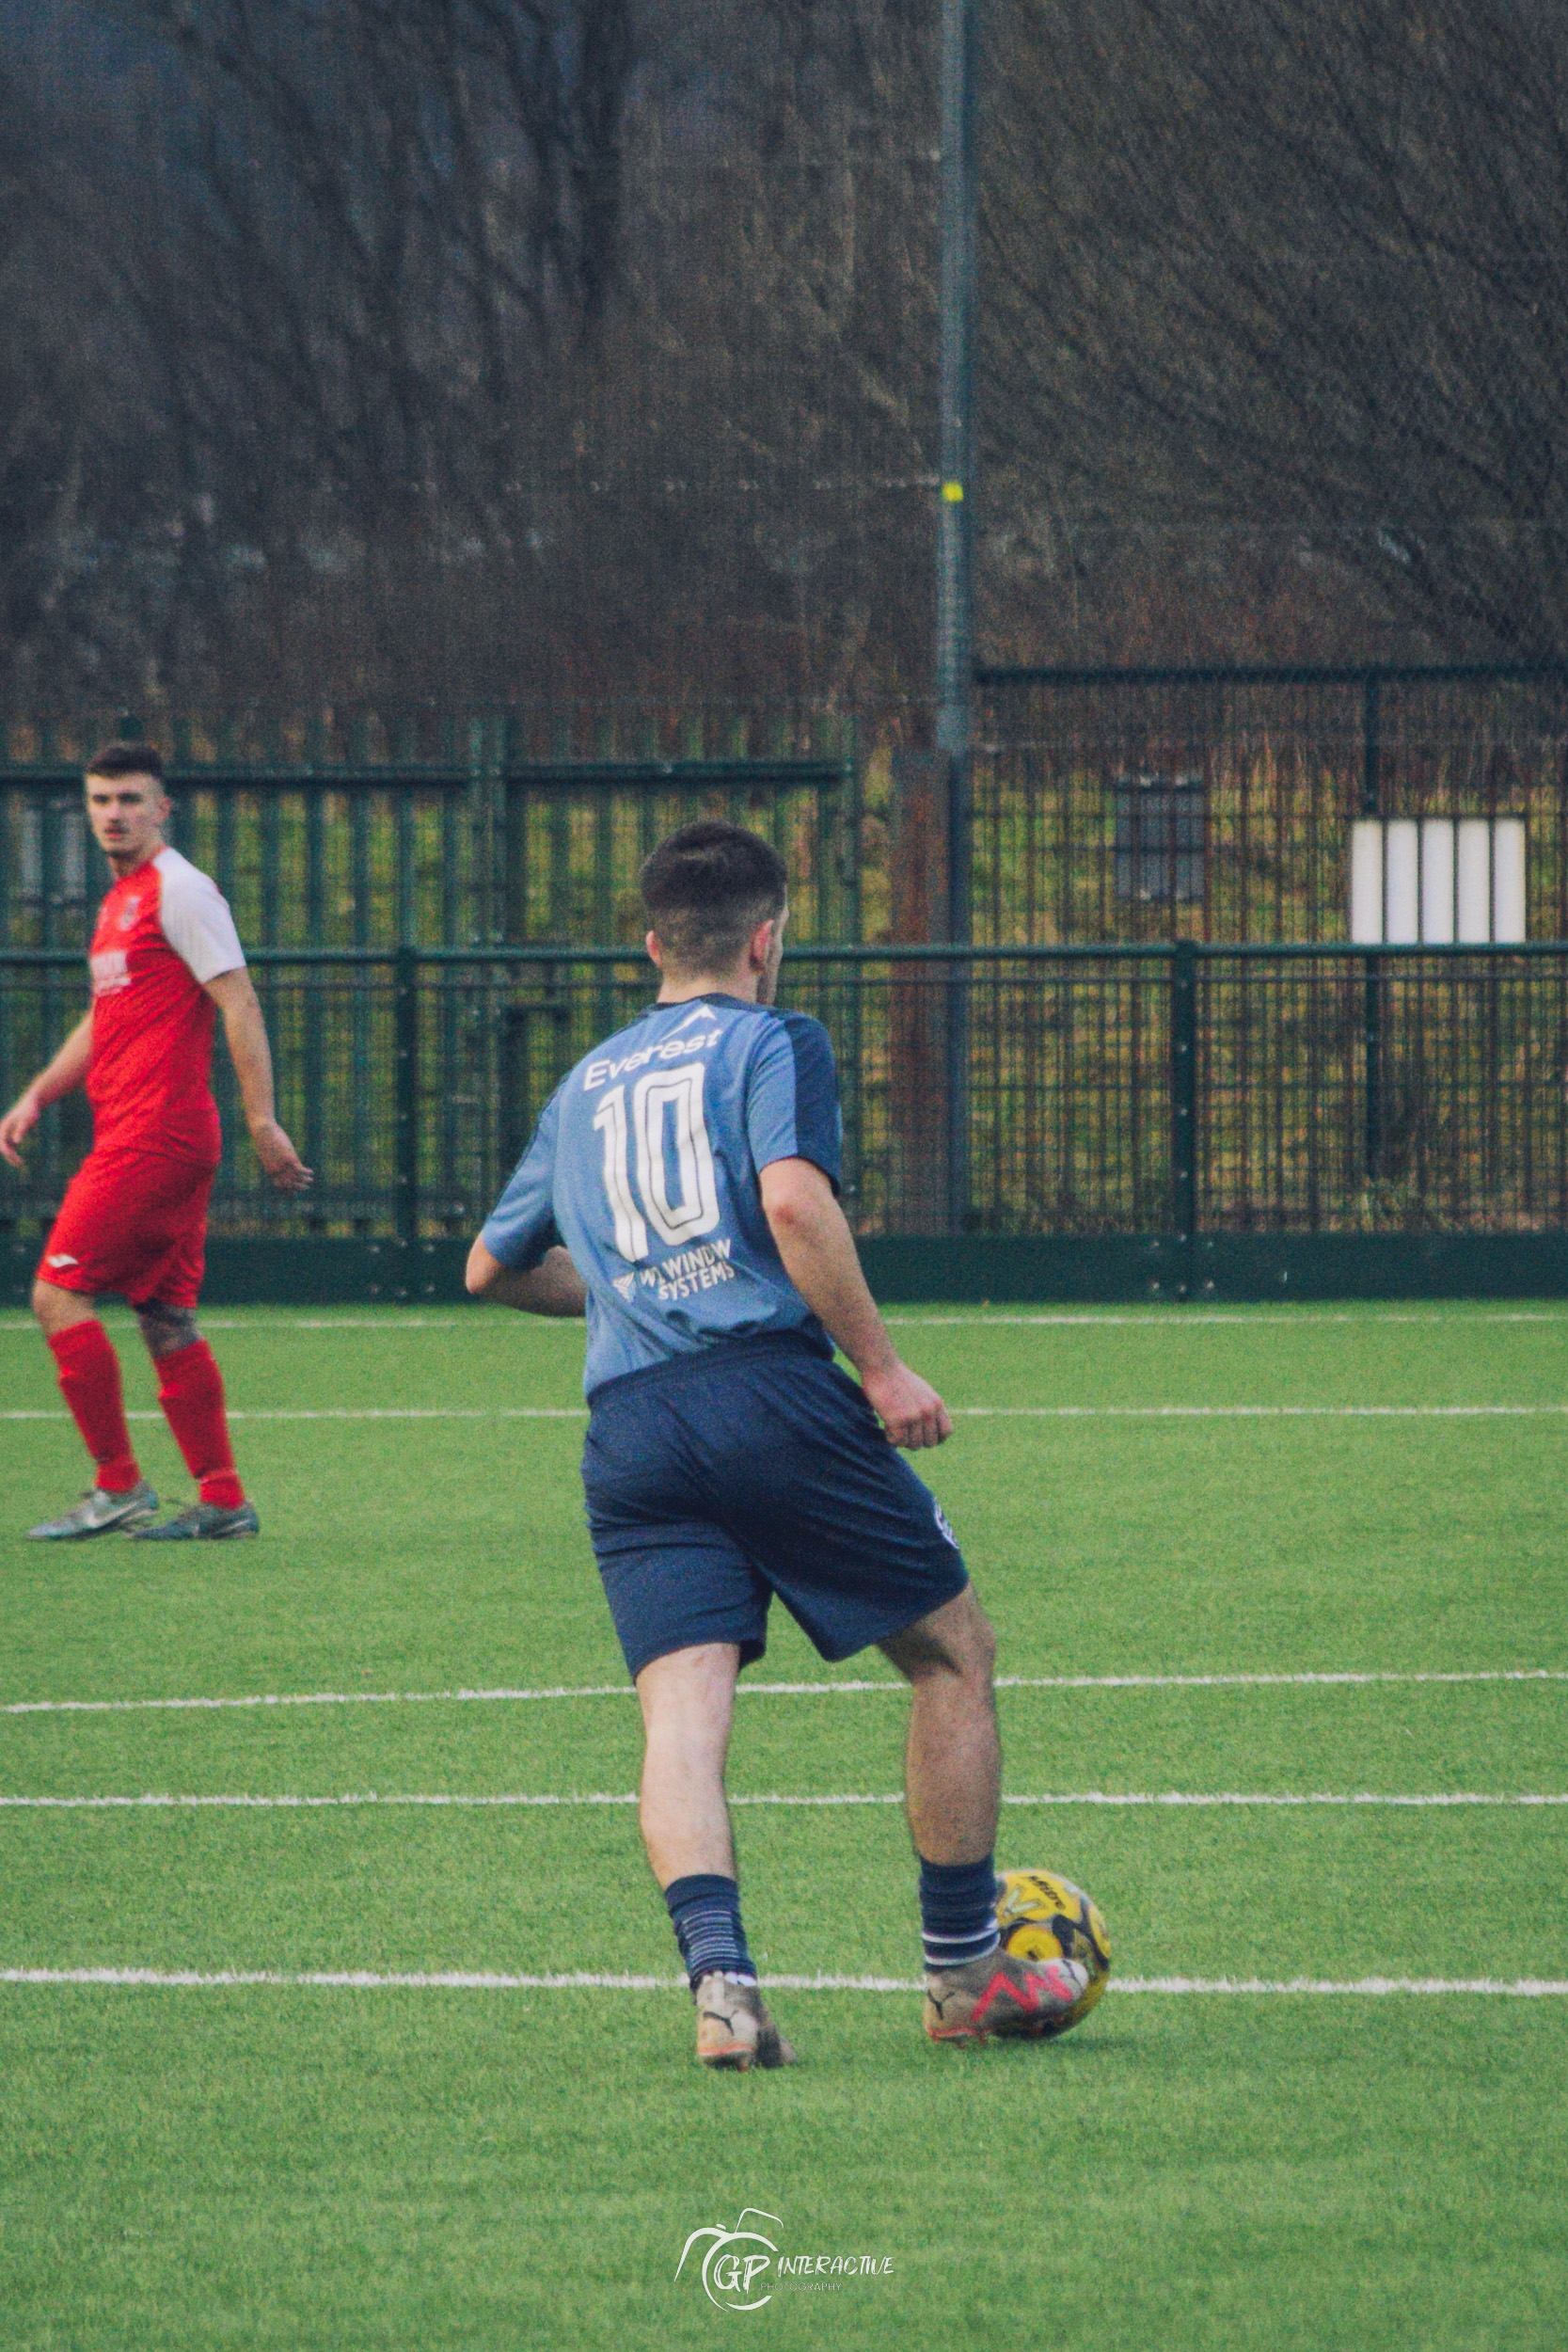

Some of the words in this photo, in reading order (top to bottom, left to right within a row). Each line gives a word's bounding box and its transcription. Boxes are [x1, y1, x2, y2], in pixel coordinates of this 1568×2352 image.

[583, 1029, 723, 1091] Everest
[593, 1061, 721, 1263] 10
[658, 1261, 735, 1300] SYSTEMS
